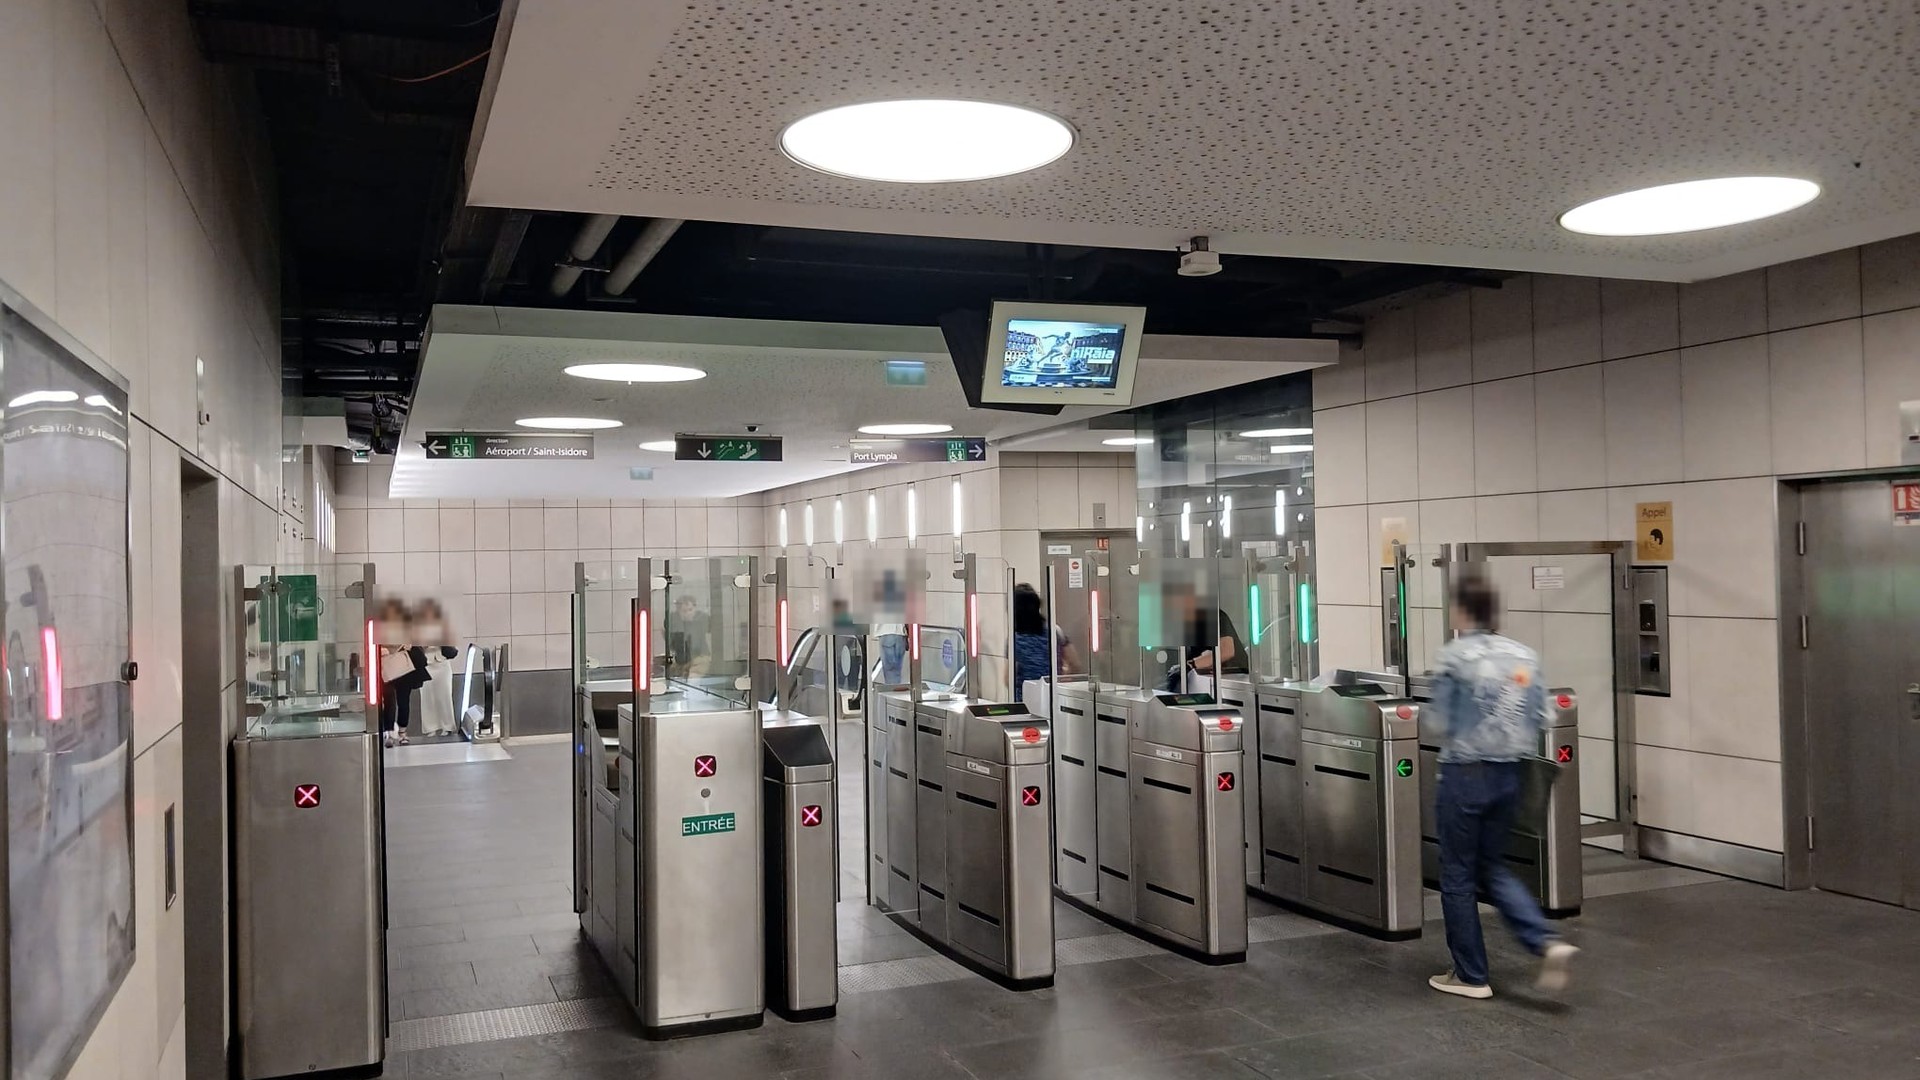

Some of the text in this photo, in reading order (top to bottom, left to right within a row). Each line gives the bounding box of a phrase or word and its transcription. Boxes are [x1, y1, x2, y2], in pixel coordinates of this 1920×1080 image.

[485, 446, 588, 457] Aéroport / Saint-Isidore
[853, 452, 898, 462] Port Lympia
[1641, 507, 1667, 519] Appel
[682, 817, 735, 834] ENTRÉE
